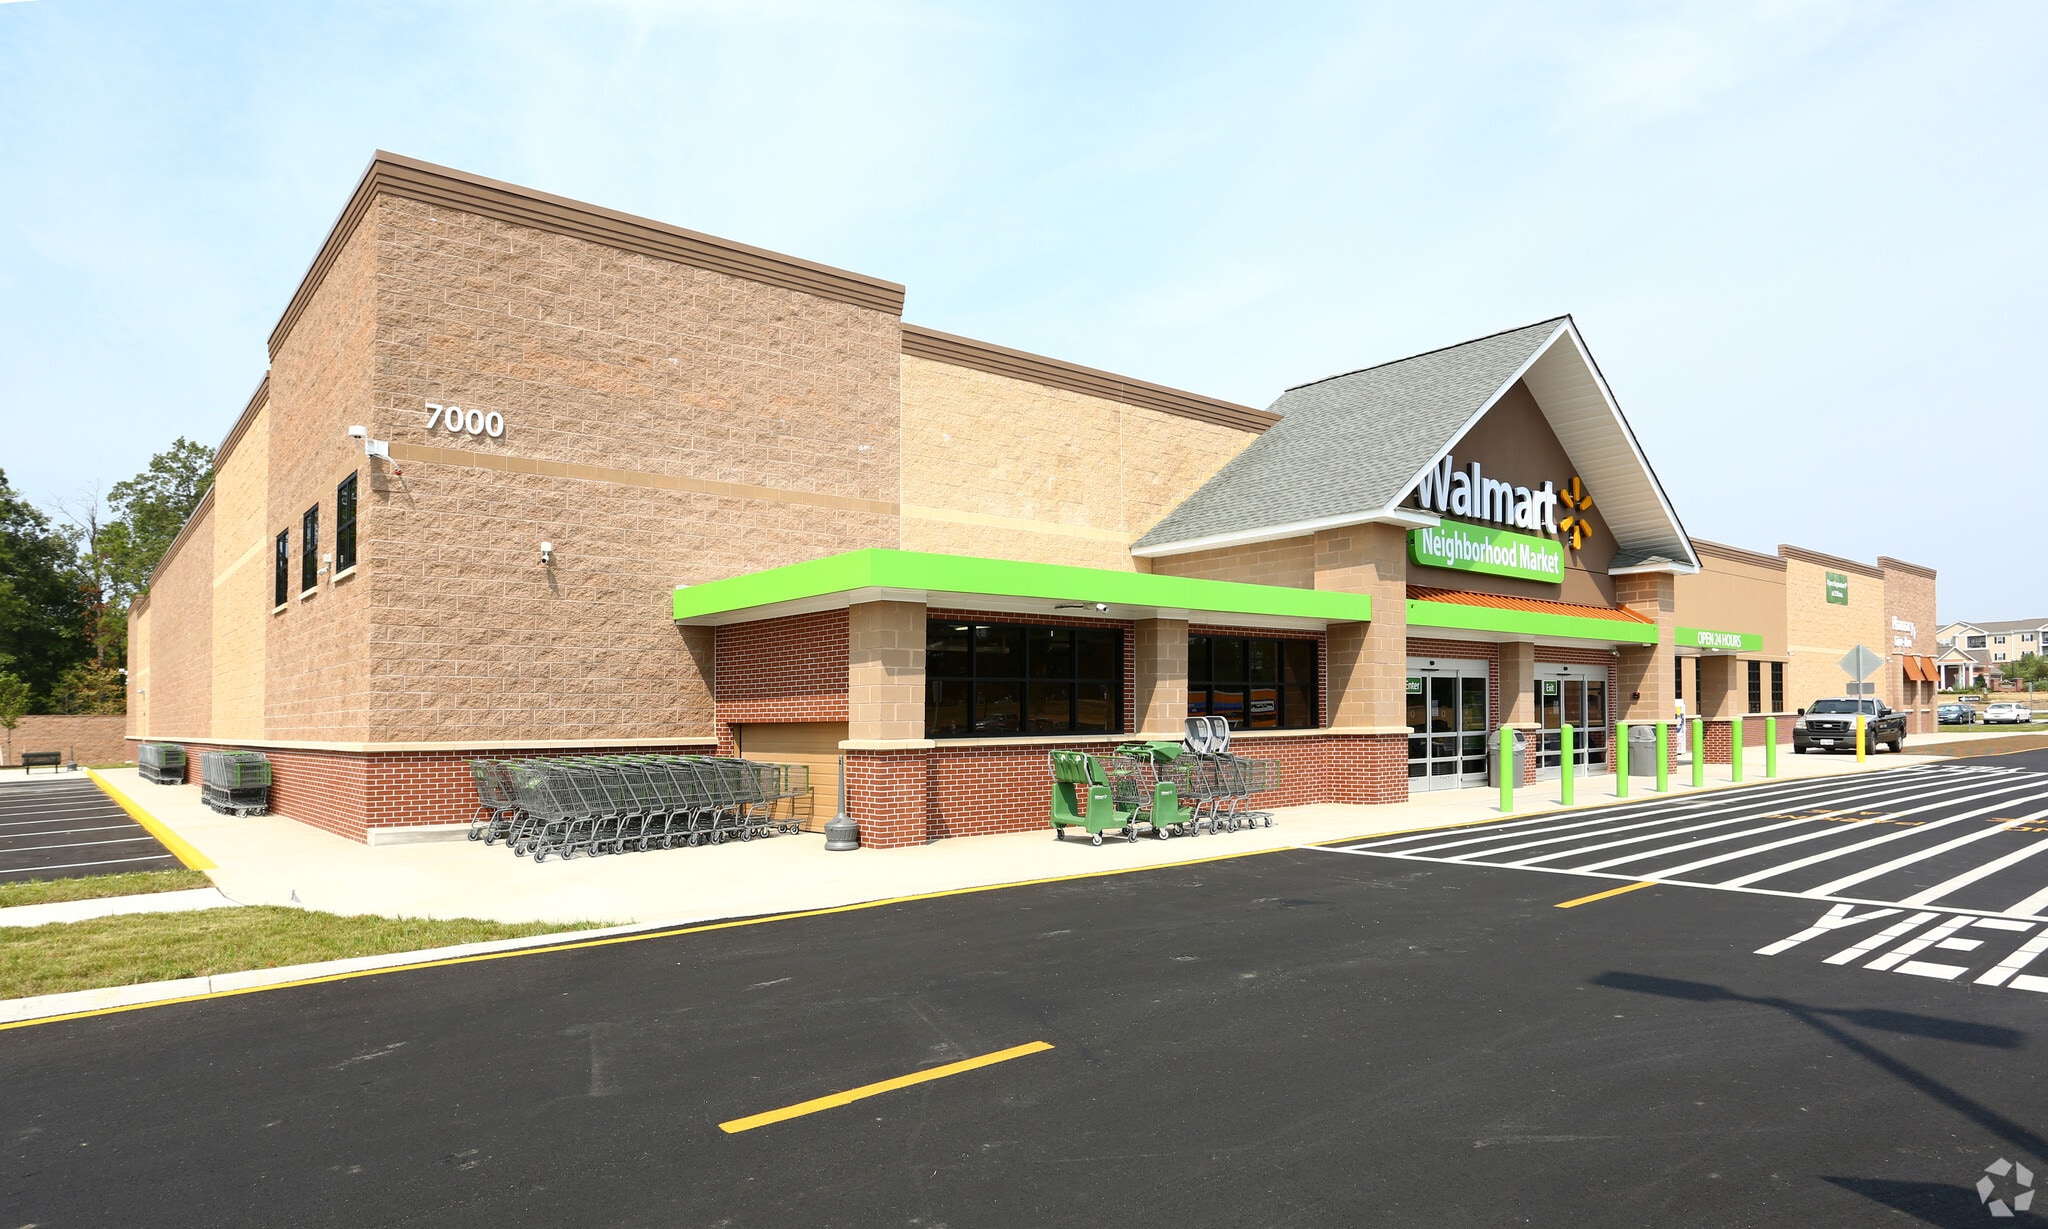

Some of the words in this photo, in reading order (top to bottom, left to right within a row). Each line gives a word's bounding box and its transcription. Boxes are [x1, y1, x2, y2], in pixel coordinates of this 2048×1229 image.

[425, 403, 504, 437] 7000
[1416, 454, 1558, 535] Walmart
[1422, 527, 1517, 566] Neighborhood
[1519, 543, 1560, 575] Market
[1697, 631, 1714, 646] OPEN
[1714, 633, 1721, 646] 24
[1722, 633, 1741, 648] HOURS
[1546, 683, 1555, 692] Exit
